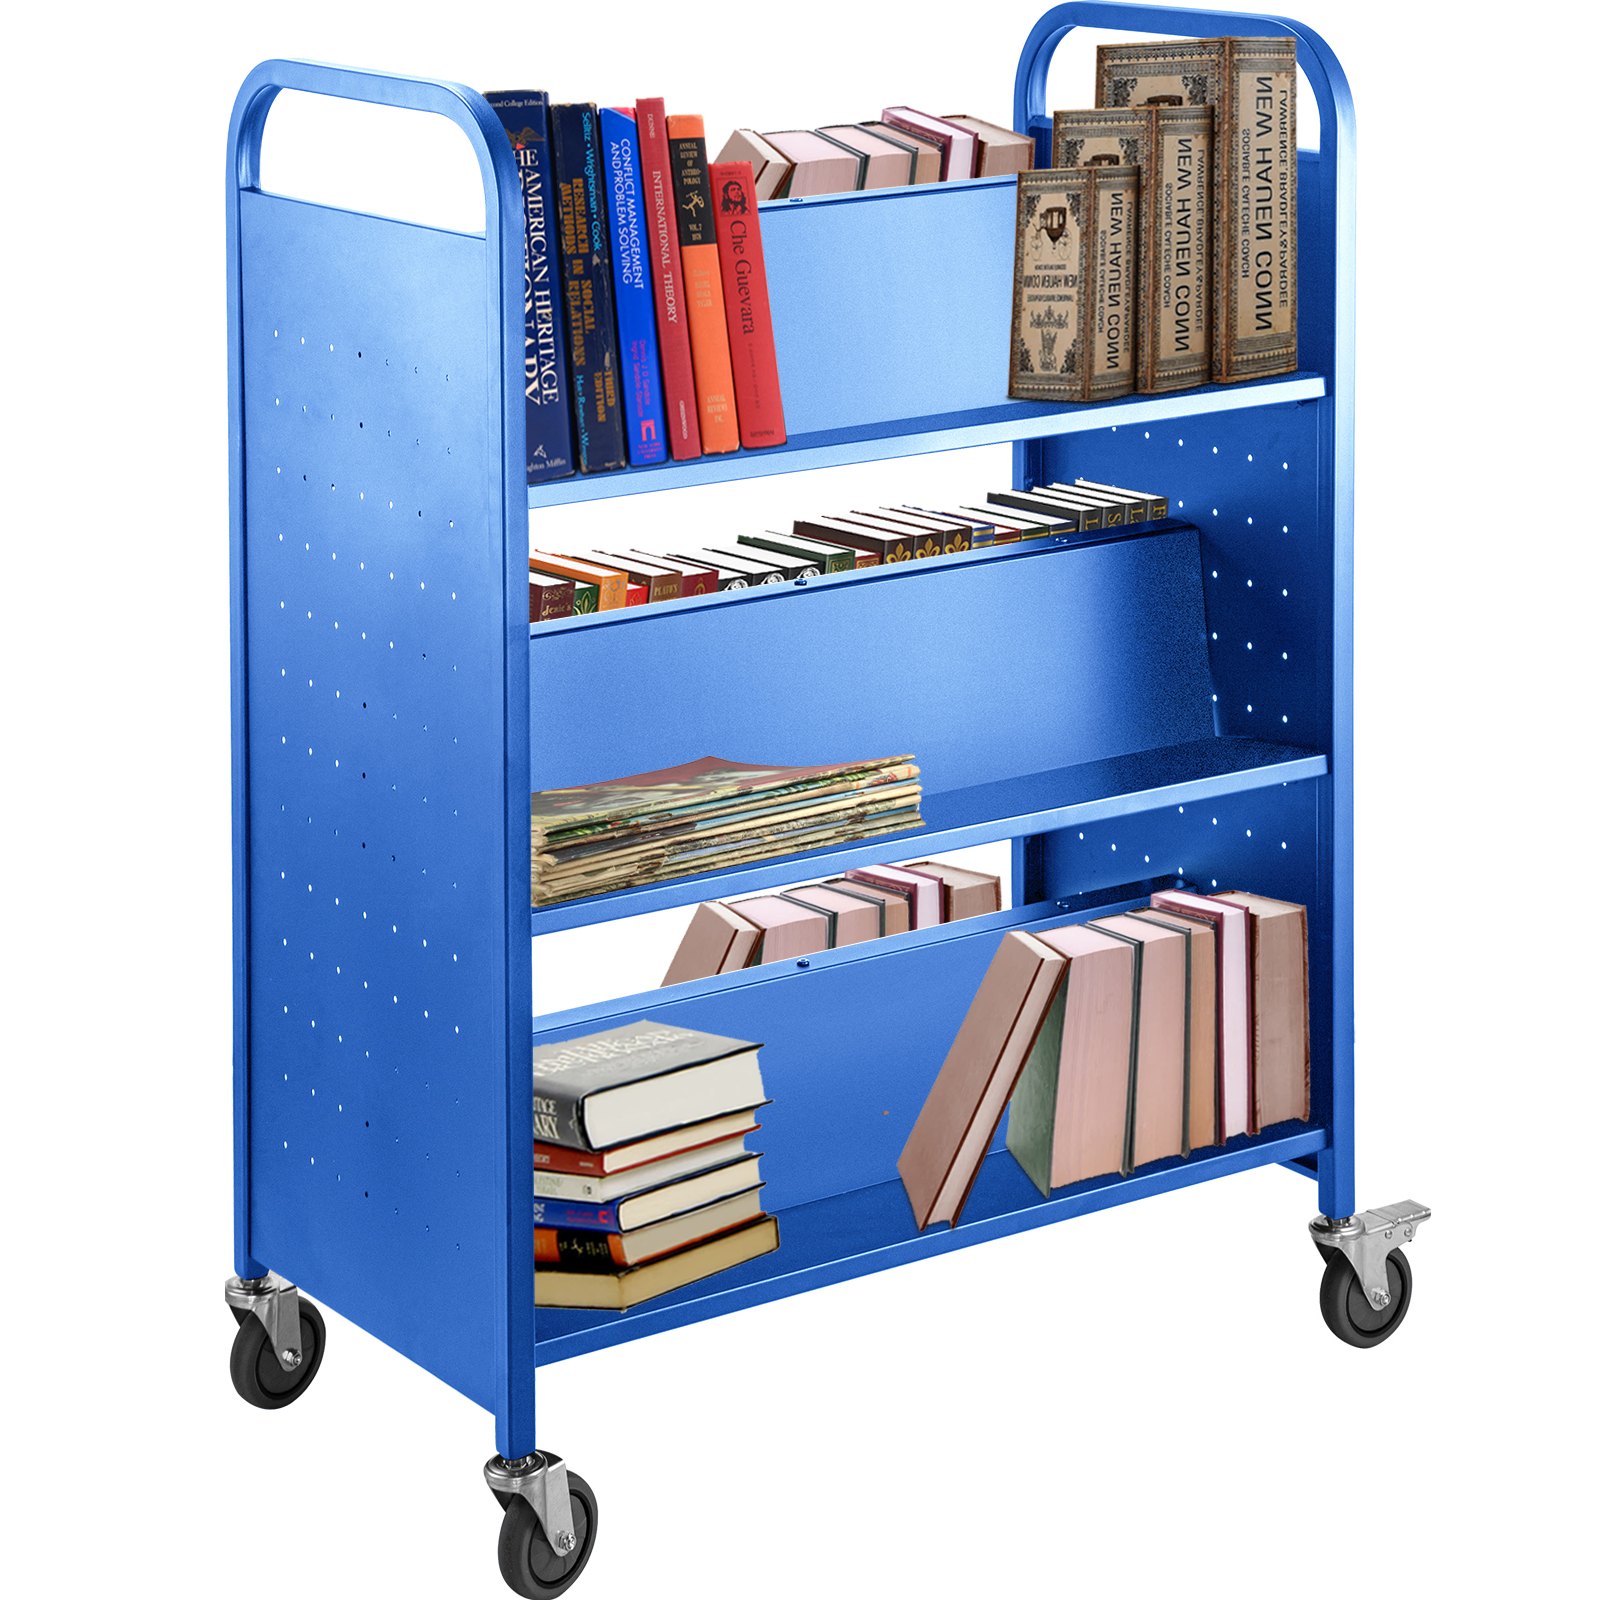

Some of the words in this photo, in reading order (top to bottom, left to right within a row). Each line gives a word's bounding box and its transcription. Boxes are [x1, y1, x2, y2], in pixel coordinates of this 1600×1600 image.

[513, 148, 539, 167] HE
[610, 142, 622, 170] AND
[620, 138, 635, 196] CONFLICT
[679, 142, 698, 150] ANNUAL
[680, 151, 698, 159] REVIEW
[525, 169, 550, 283] AMERICAN
[561, 183, 577, 254] METHODS
[572, 178, 590, 253] RESEARCH
[584, 149, 597, 212] Wrightsman
[591, 221, 603, 251] Cook
[613, 170, 627, 225] PROBLEM
[618, 227, 633, 284] SOLVING
[626, 197, 644, 289] MANAGEMENT
[652, 171, 671, 268] INTERNATIONAL
[663, 272, 678, 324] THEORY
[730, 220, 747, 255] Che
[572, 259, 584, 275] IN
[568, 280, 586, 366] RELATIONS
[581, 279, 595, 331] SOCIAL
[735, 259, 754, 335] Guevara
[534, 290, 559, 404] HERITAGE
[593, 372, 606, 423] EDITION
[604, 368, 616, 407] THIRD
